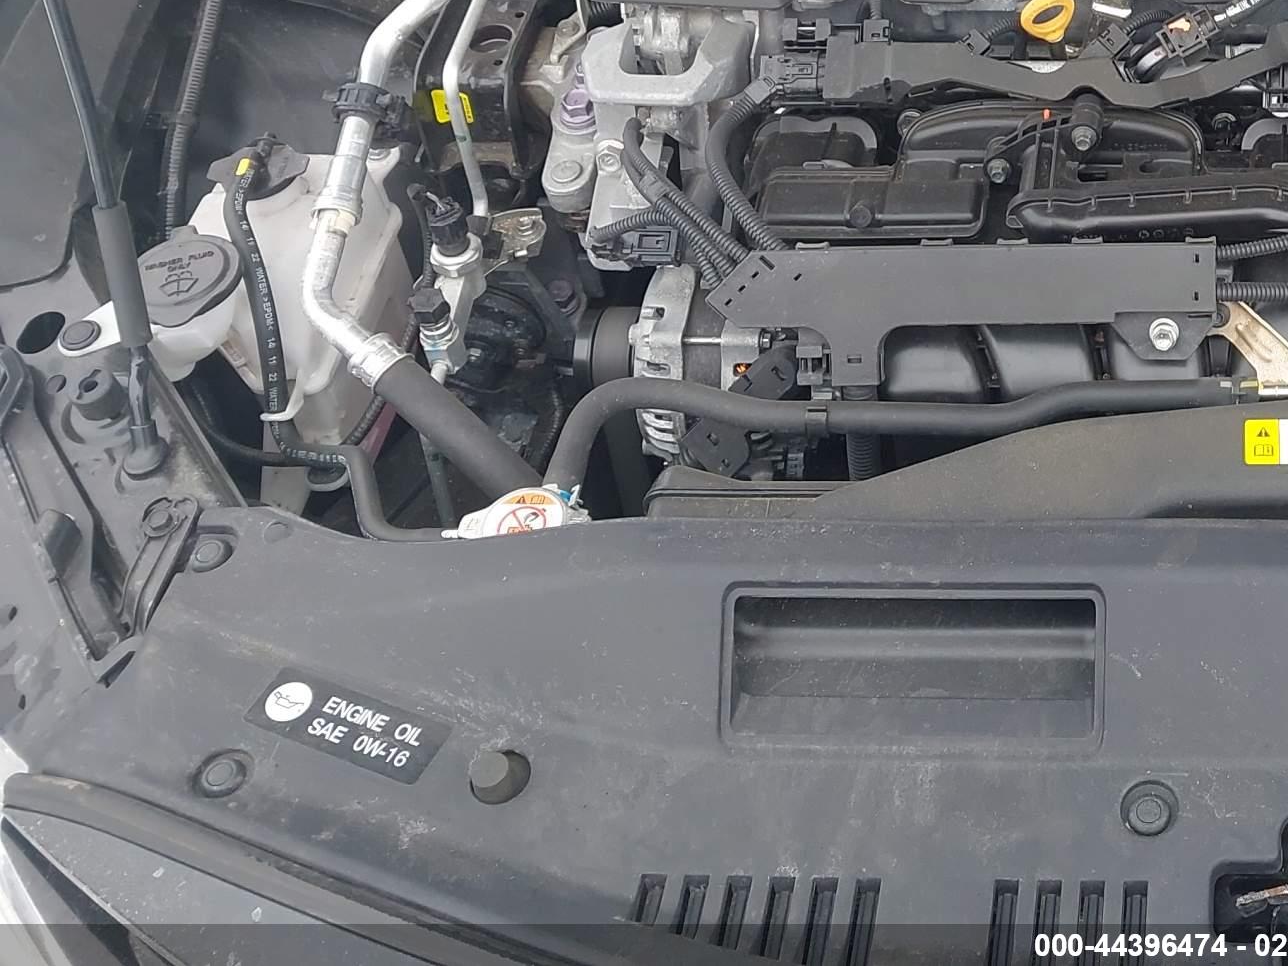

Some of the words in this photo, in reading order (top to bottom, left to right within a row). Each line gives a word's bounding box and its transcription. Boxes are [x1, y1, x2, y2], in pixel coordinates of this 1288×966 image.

[256, 266, 268, 295] WATER
[268, 372, 278, 382] 22
[268, 387, 278, 411] WATER
[322, 696, 390, 732] ENGINE
[394, 723, 423, 747] OIL
[307, 717, 350, 744] SAE
[352, 735, 410, 767] 0W-16
